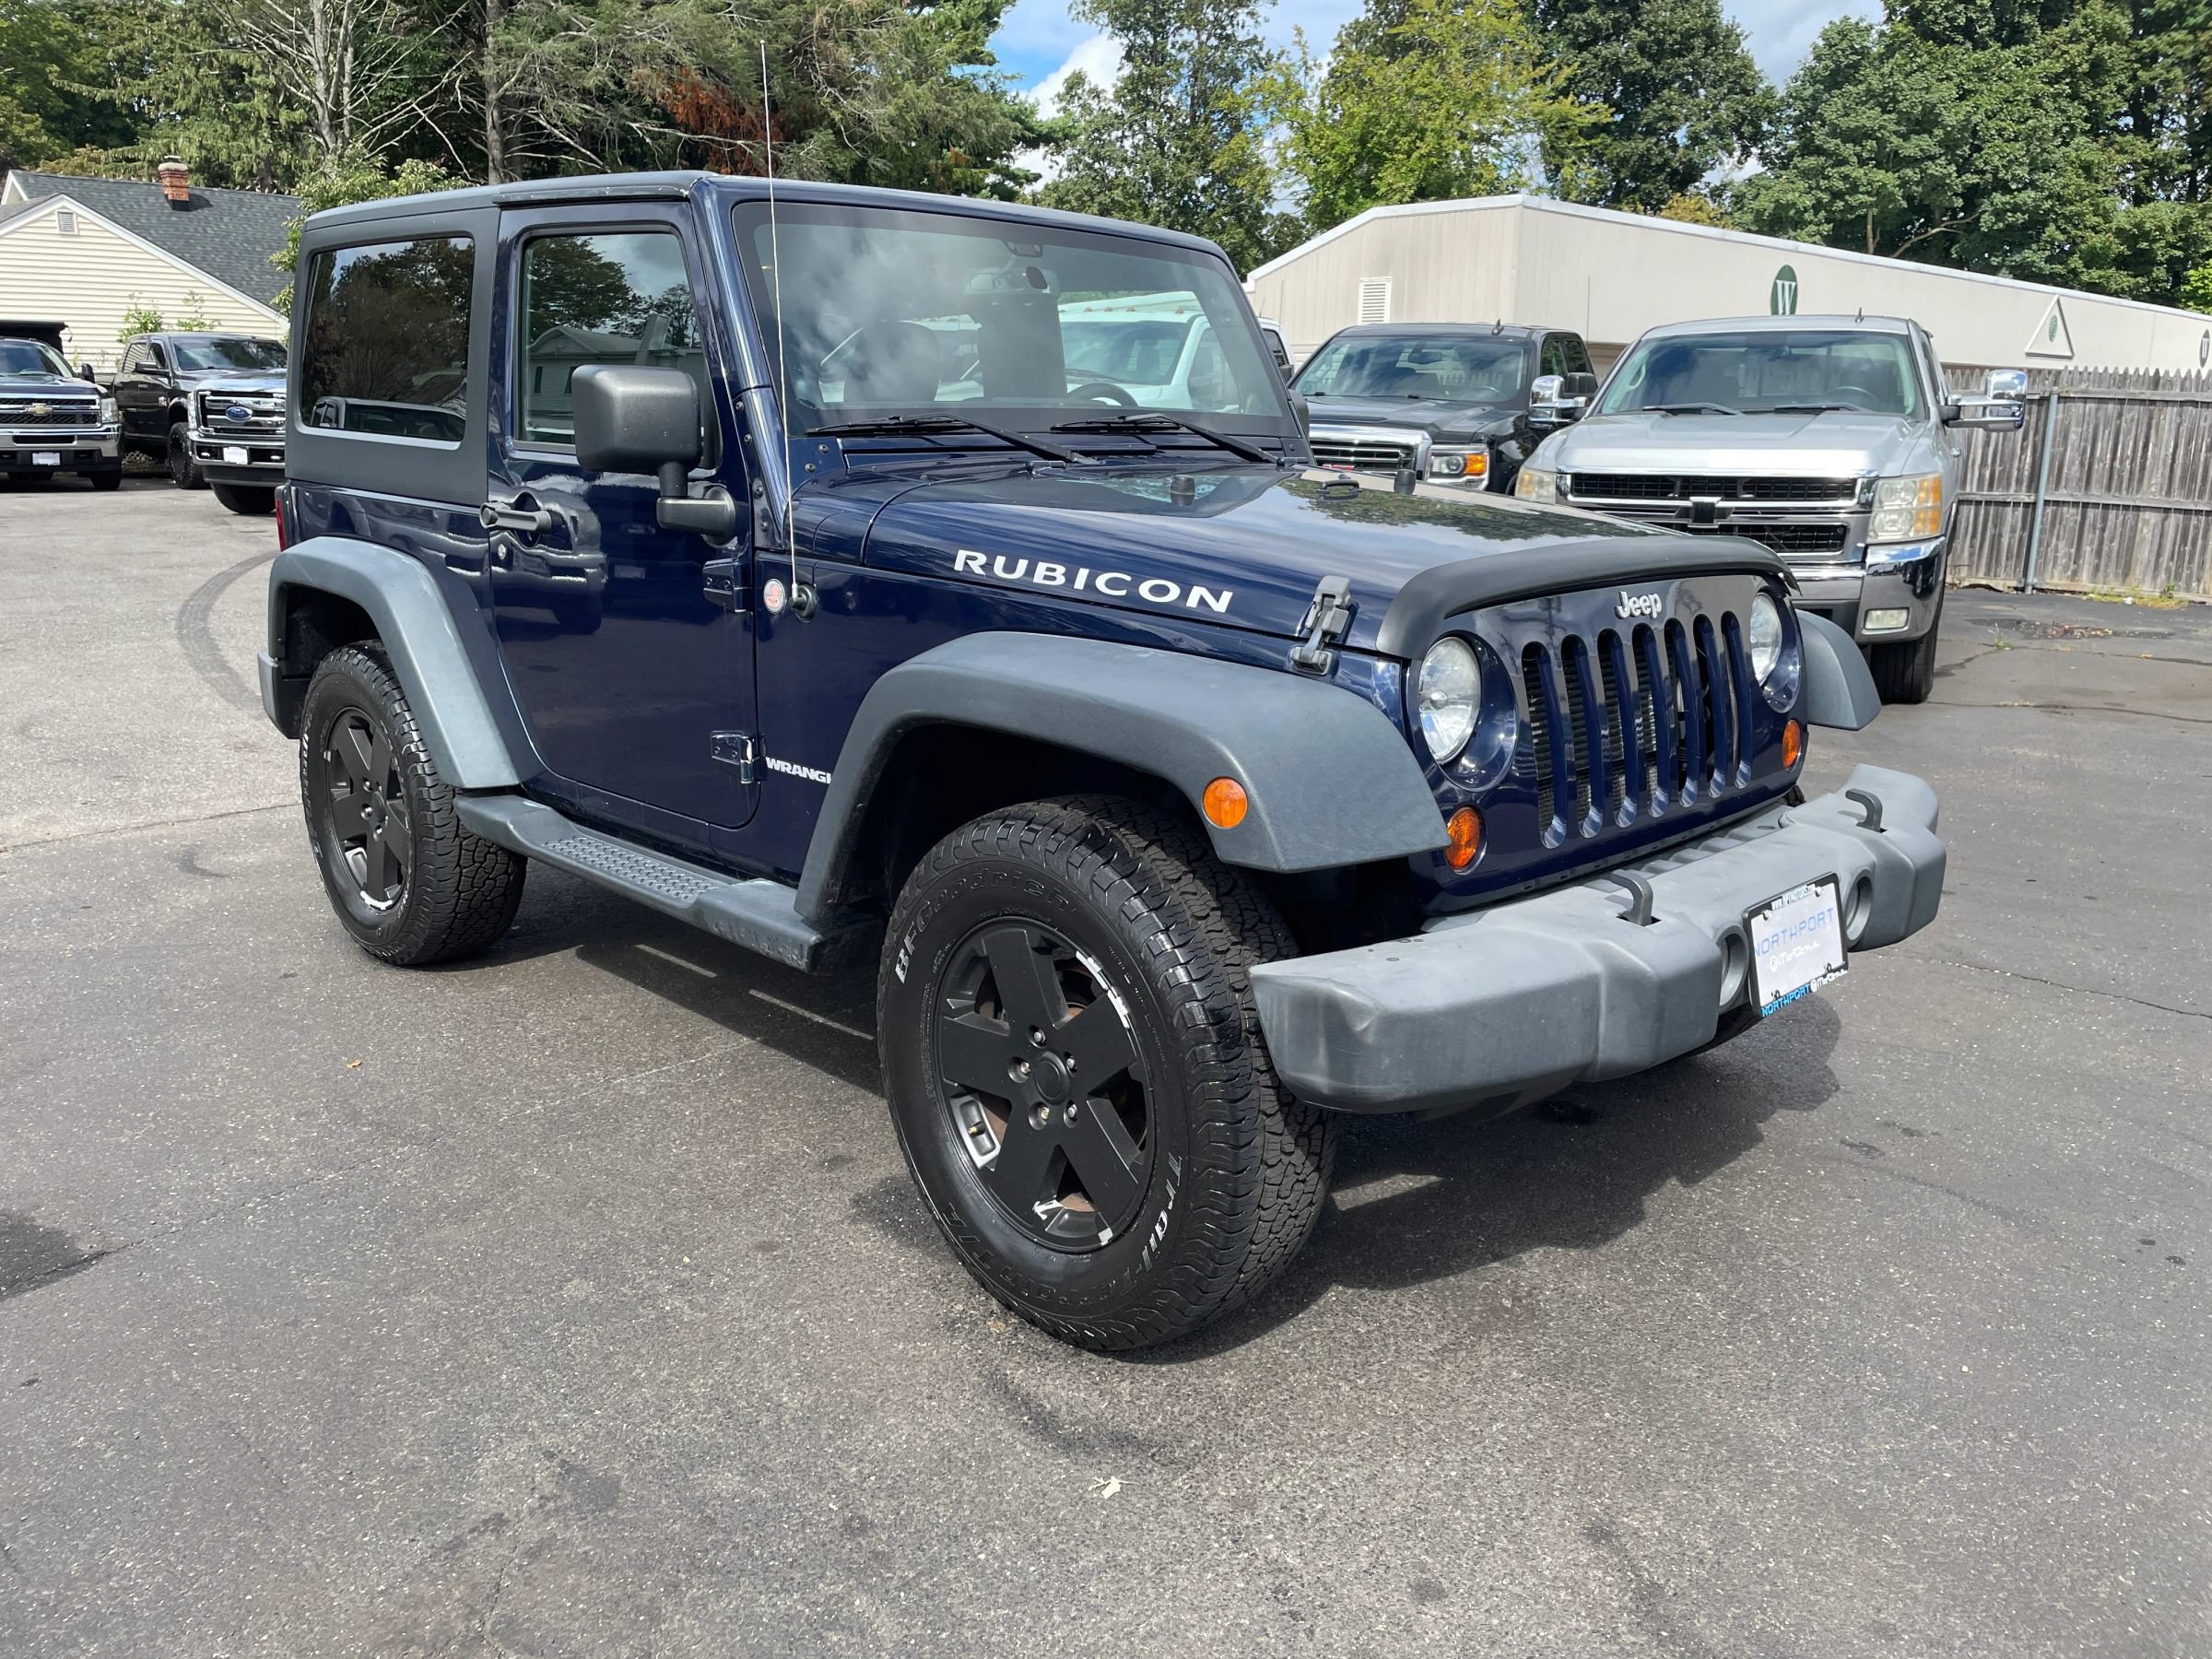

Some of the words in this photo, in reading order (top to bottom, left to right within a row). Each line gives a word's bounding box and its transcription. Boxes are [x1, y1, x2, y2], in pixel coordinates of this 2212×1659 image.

[1775, 279, 1796, 316] W
[953, 549, 1233, 613] RUBICON
[1614, 591, 1662, 619] Jeep
[1755, 907, 1834, 956] NORTHPORT
[1760, 983, 1810, 1018] NORTHPORT
